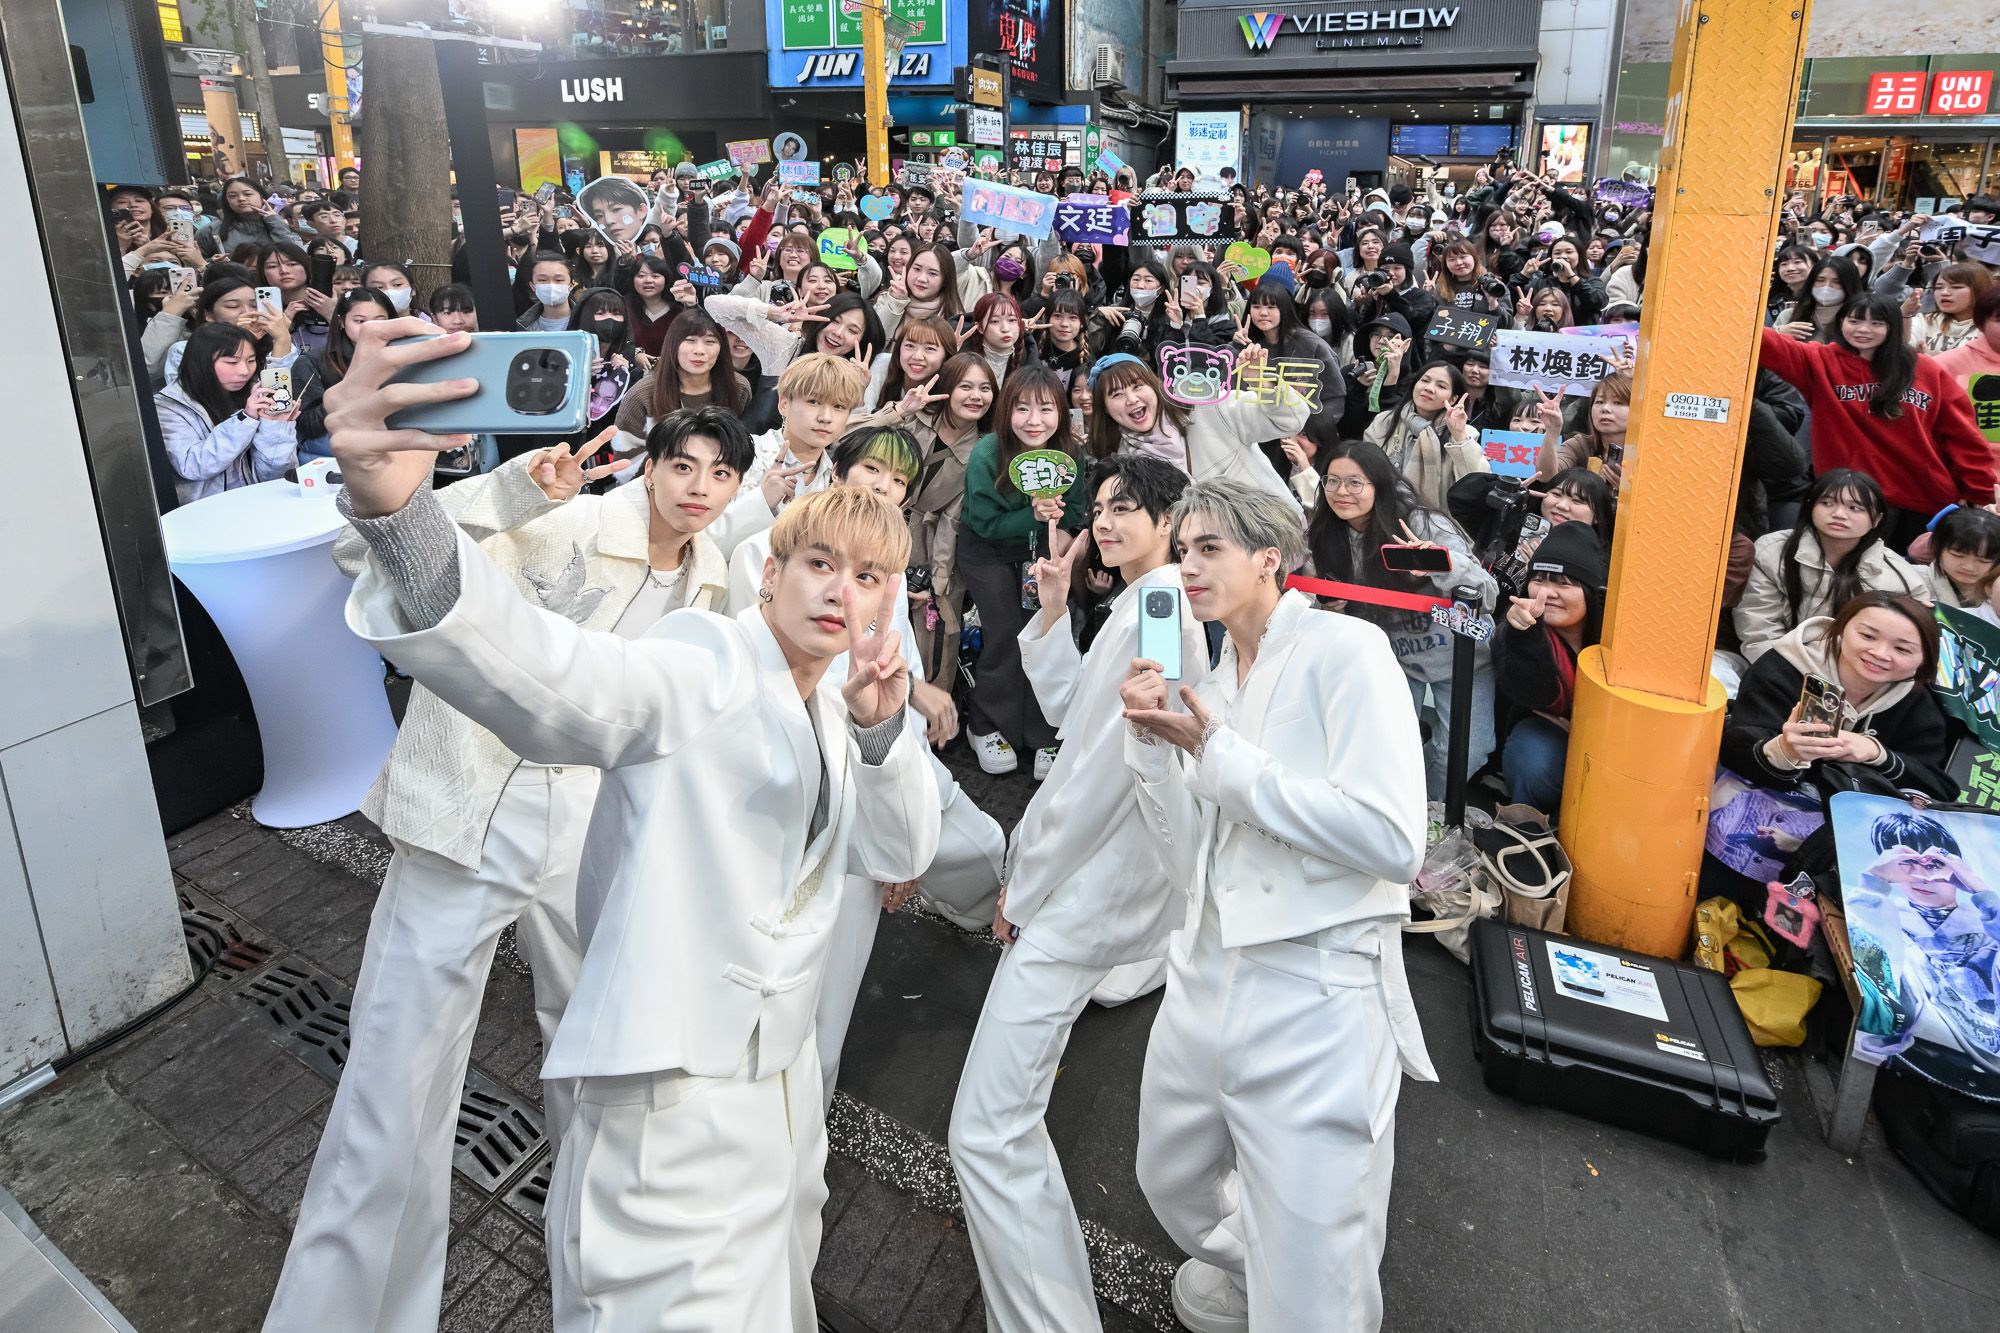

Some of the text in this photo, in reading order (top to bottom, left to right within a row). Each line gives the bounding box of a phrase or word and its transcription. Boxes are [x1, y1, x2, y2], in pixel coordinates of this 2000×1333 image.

[1292, 7, 1461, 33] VIESHOW
[1316, 35, 1423, 48] CINEMAS
[796, 53, 857, 84] JUN
[561, 77, 623, 103] LUSH
[1941, 76, 1981, 92] UNI
[1938, 94, 1982, 111] QLO
[1014, 140, 1062, 157] 林佳辰
[1019, 156, 1043, 171] 凌凌
[1059, 205, 1113, 234] 文廷
[1435, 317, 1483, 342] 子翔
[1509, 345, 1608, 382] 林煥鈞
[1231, 356, 1321, 410] 佳辰
[1671, 394, 1722, 408] 0901131
[1017, 457, 1058, 492] 鈞
[1513, 936, 1537, 1012] PELICAN AIR
[1605, 972, 1636, 984] PELICAN
[1668, 1037, 1697, 1048] PELICAN
